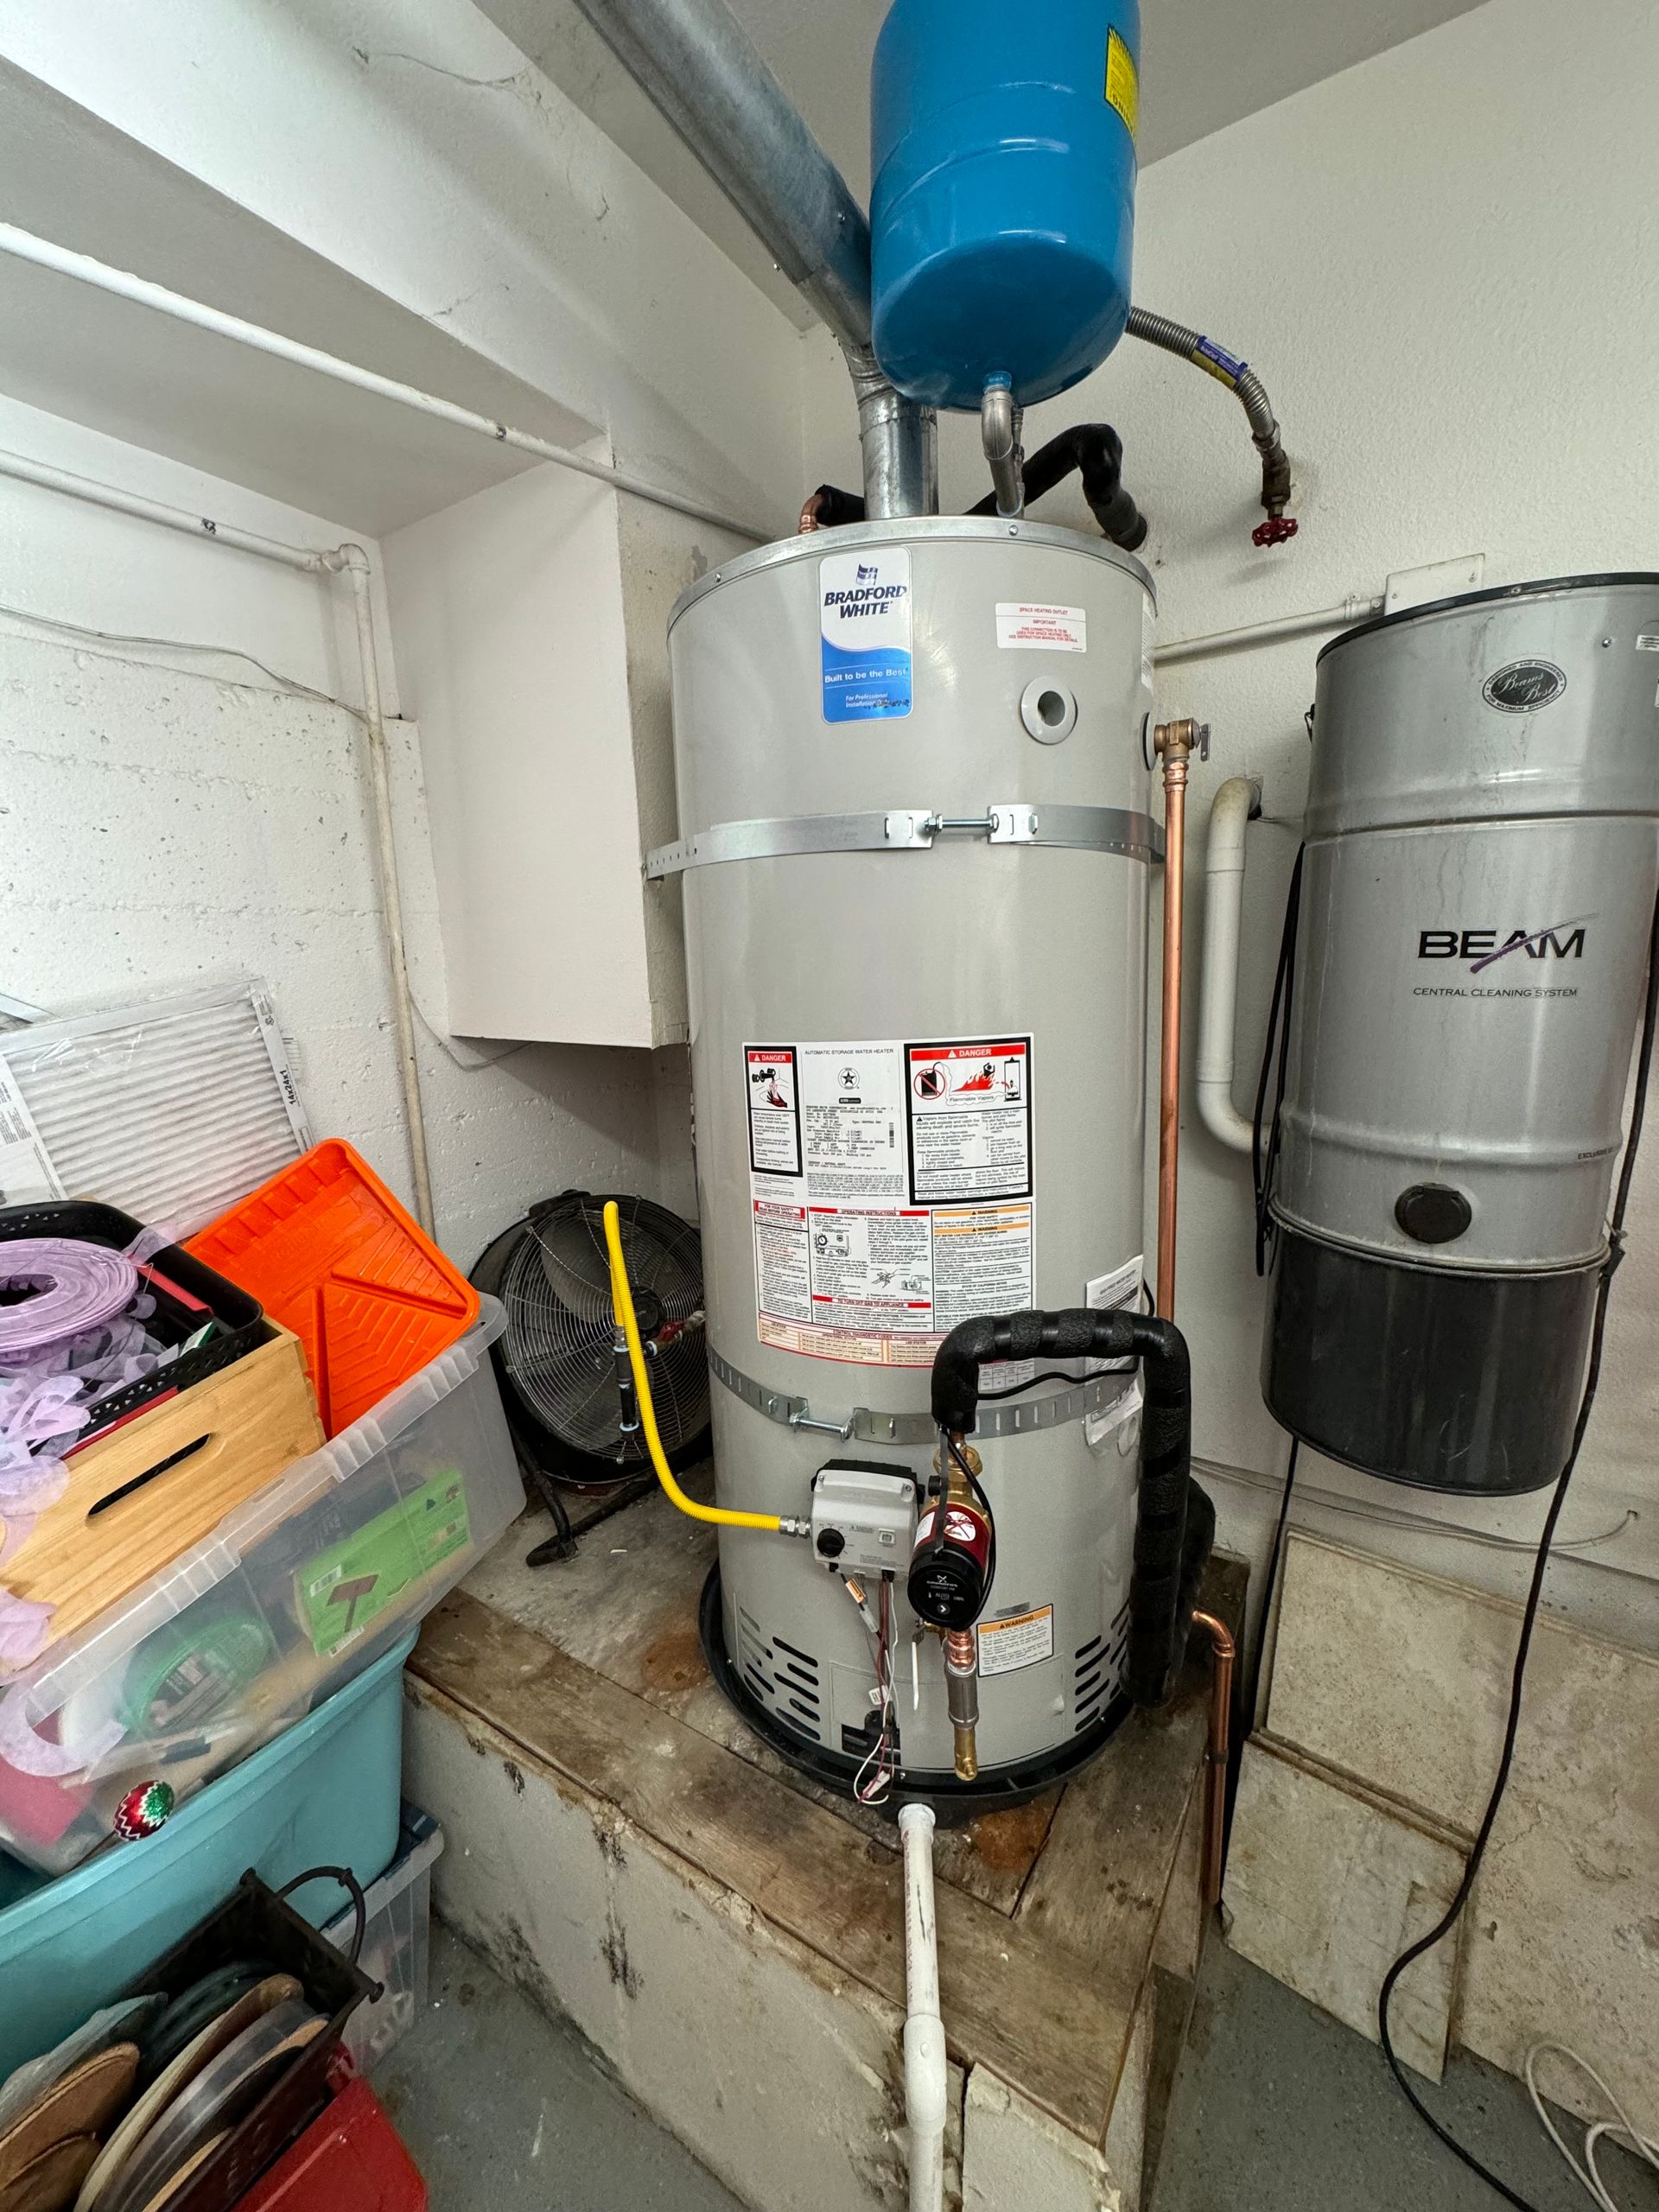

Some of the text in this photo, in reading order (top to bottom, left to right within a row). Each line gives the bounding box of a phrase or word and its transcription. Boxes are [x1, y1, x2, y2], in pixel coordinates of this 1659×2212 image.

[824, 585, 907, 607] BRADFORD
[840, 601, 890, 620] WHITE
[824, 675, 842, 683] Built
[869, 670, 883, 678] the
[1486, 695, 1496, 703] FOR
[1516, 683, 1556, 705] Best
[1417, 928, 1586, 959] BEAM
[1413, 988, 1578, 997] CENTRAL CLEANING SYSTEM
[761, 1052, 786, 1062] DANGER
[958, 1048, 992, 1057] DANGER
[279, 1069, 296, 1105] 14x24x1
[1005, 1614, 1034, 1628] WARNING
